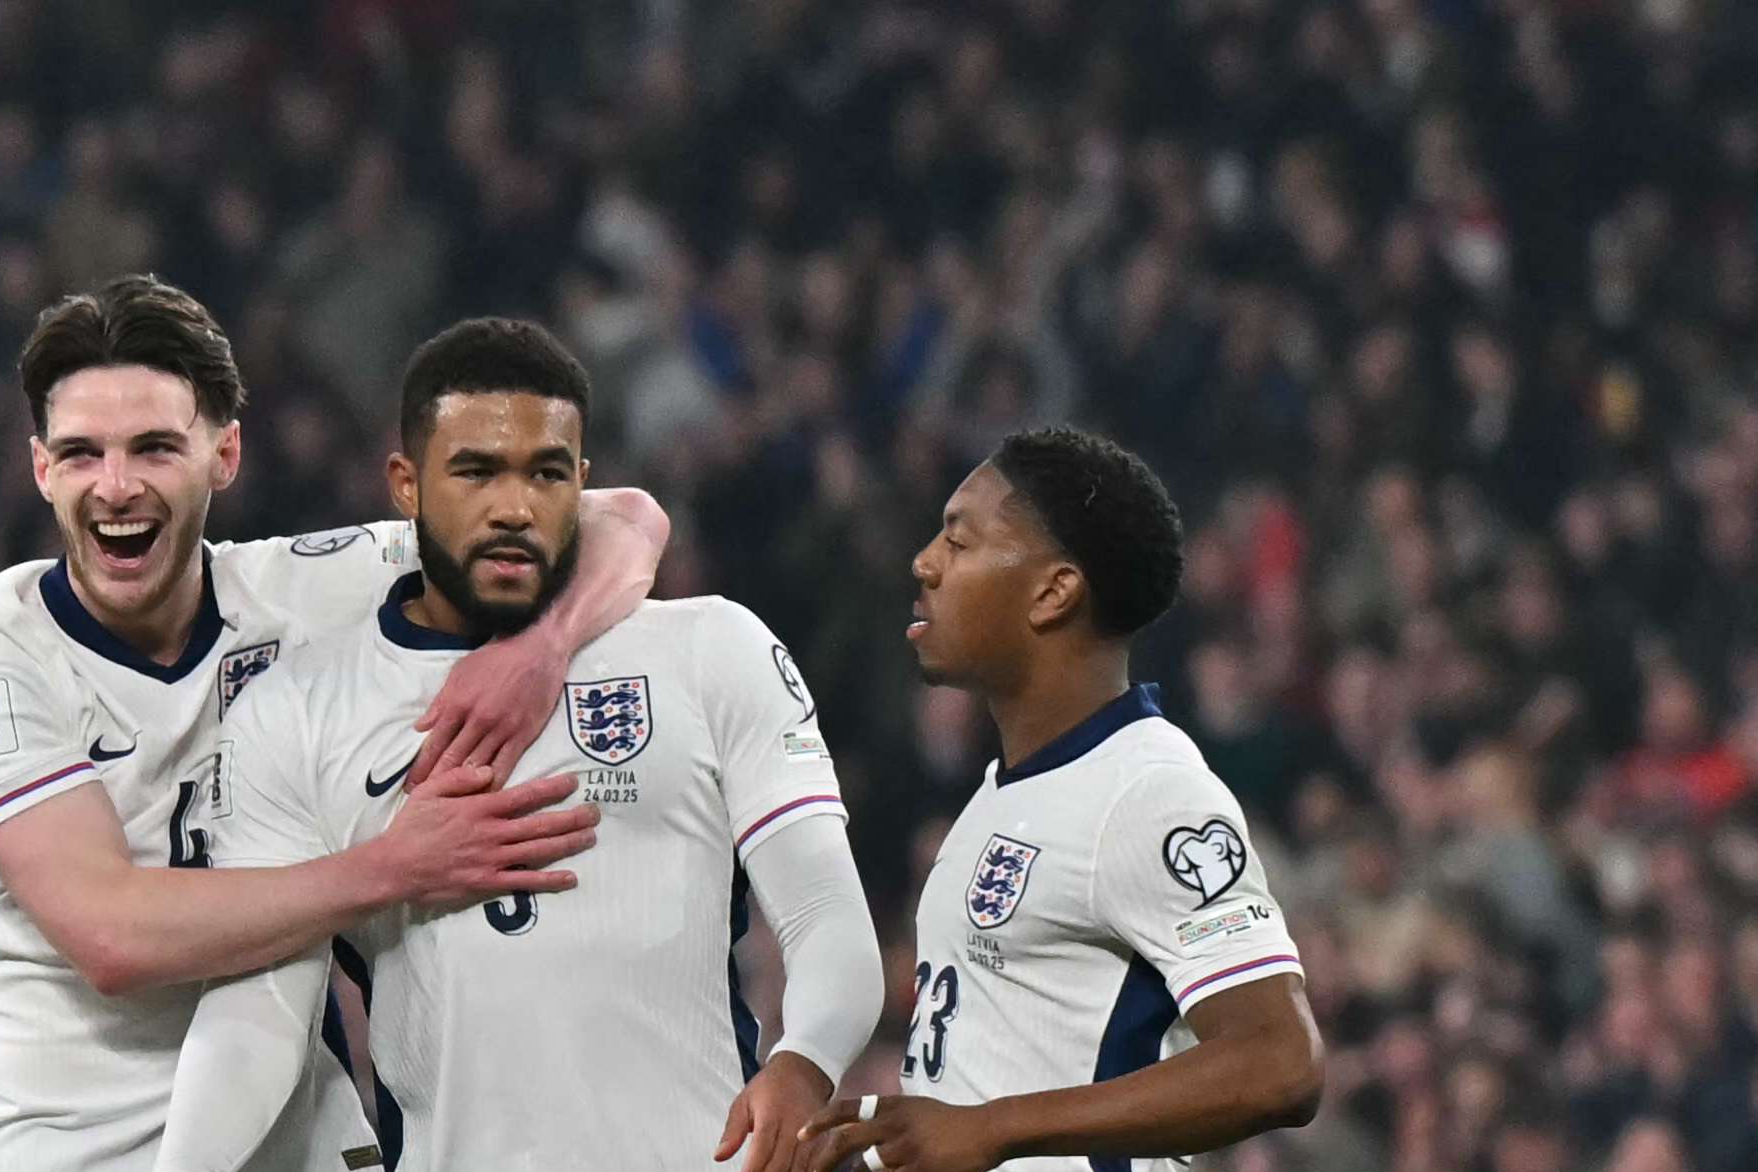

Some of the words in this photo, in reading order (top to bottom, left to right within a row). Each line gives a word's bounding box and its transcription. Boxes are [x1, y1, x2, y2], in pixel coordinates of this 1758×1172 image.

[588, 770, 636, 785] LATVIA
[584, 788, 638, 802] 24.03.25
[901, 961, 960, 1083] 23
